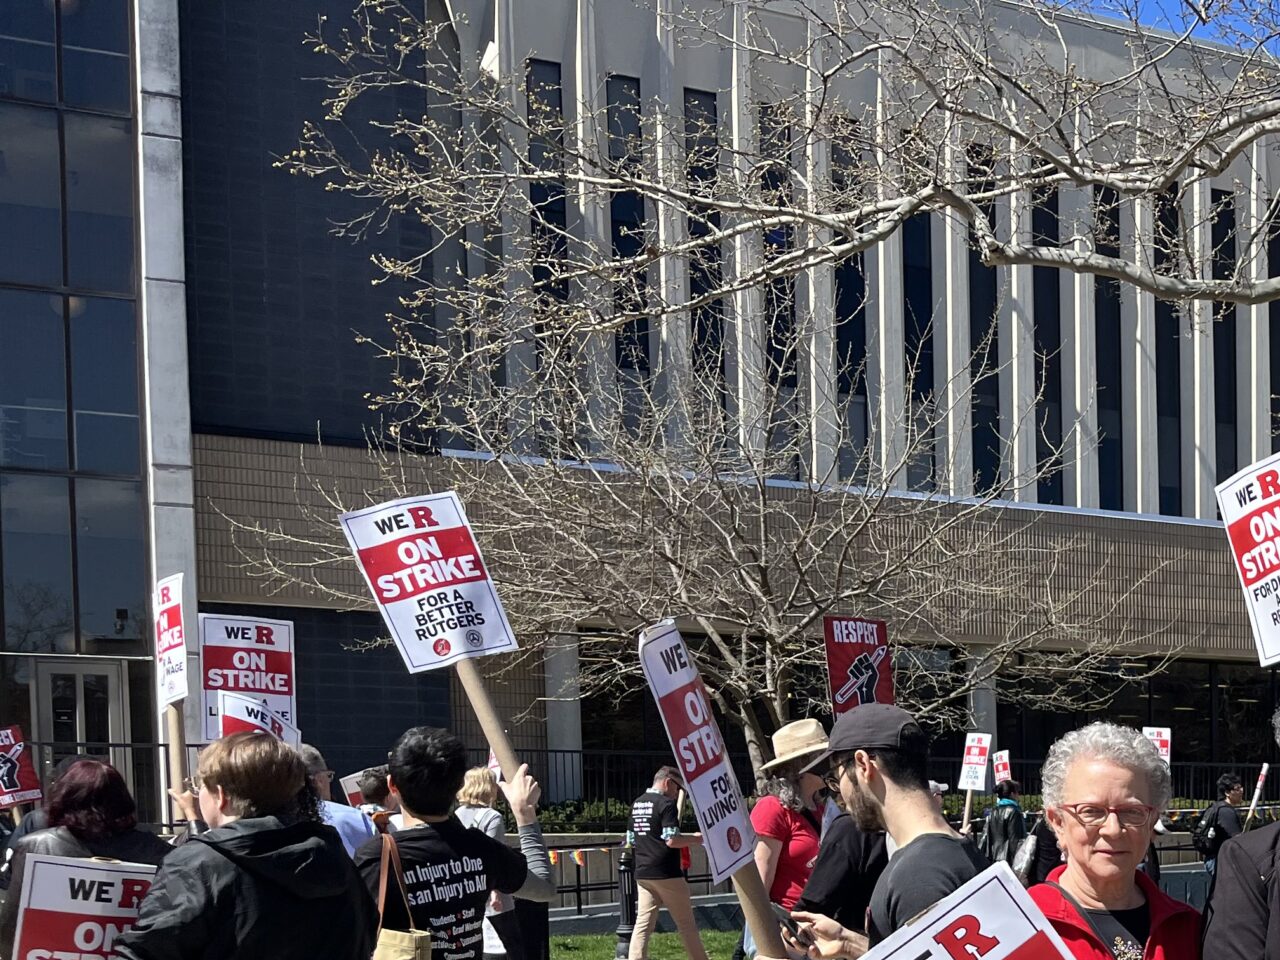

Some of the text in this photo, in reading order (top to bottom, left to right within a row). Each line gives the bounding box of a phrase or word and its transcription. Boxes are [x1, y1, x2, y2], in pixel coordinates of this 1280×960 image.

[1235, 483, 1258, 508] WE
[374, 506, 439, 535] WE R
[397, 536, 443, 565] ON
[377, 554, 481, 598] STRIKE
[161, 586, 172, 604] R
[417, 589, 464, 611] FOR A
[1253, 582, 1272, 602] FOR
[415, 601, 476, 626] BETTER
[415, 613, 485, 641] RUTGERS
[225, 625, 275, 645] WE R
[833, 621, 878, 645] RESPECT
[233, 651, 266, 670] ON
[660, 643, 686, 674] WE
[208, 668, 288, 692] STRIKE
[245, 705, 269, 725] WE
[271, 717, 284, 741] R
[710, 772, 732, 799] FOR
[702, 794, 737, 830] LIVING
[416, 862, 449, 883] Injury
[450, 859, 462, 874] to
[462, 856, 483, 872] One
[68, 878, 152, 909] WE R
[417, 888, 432, 904] an
[433, 882, 462, 902] Injury
[464, 878, 475, 894] to
[475, 874, 487, 891] All
